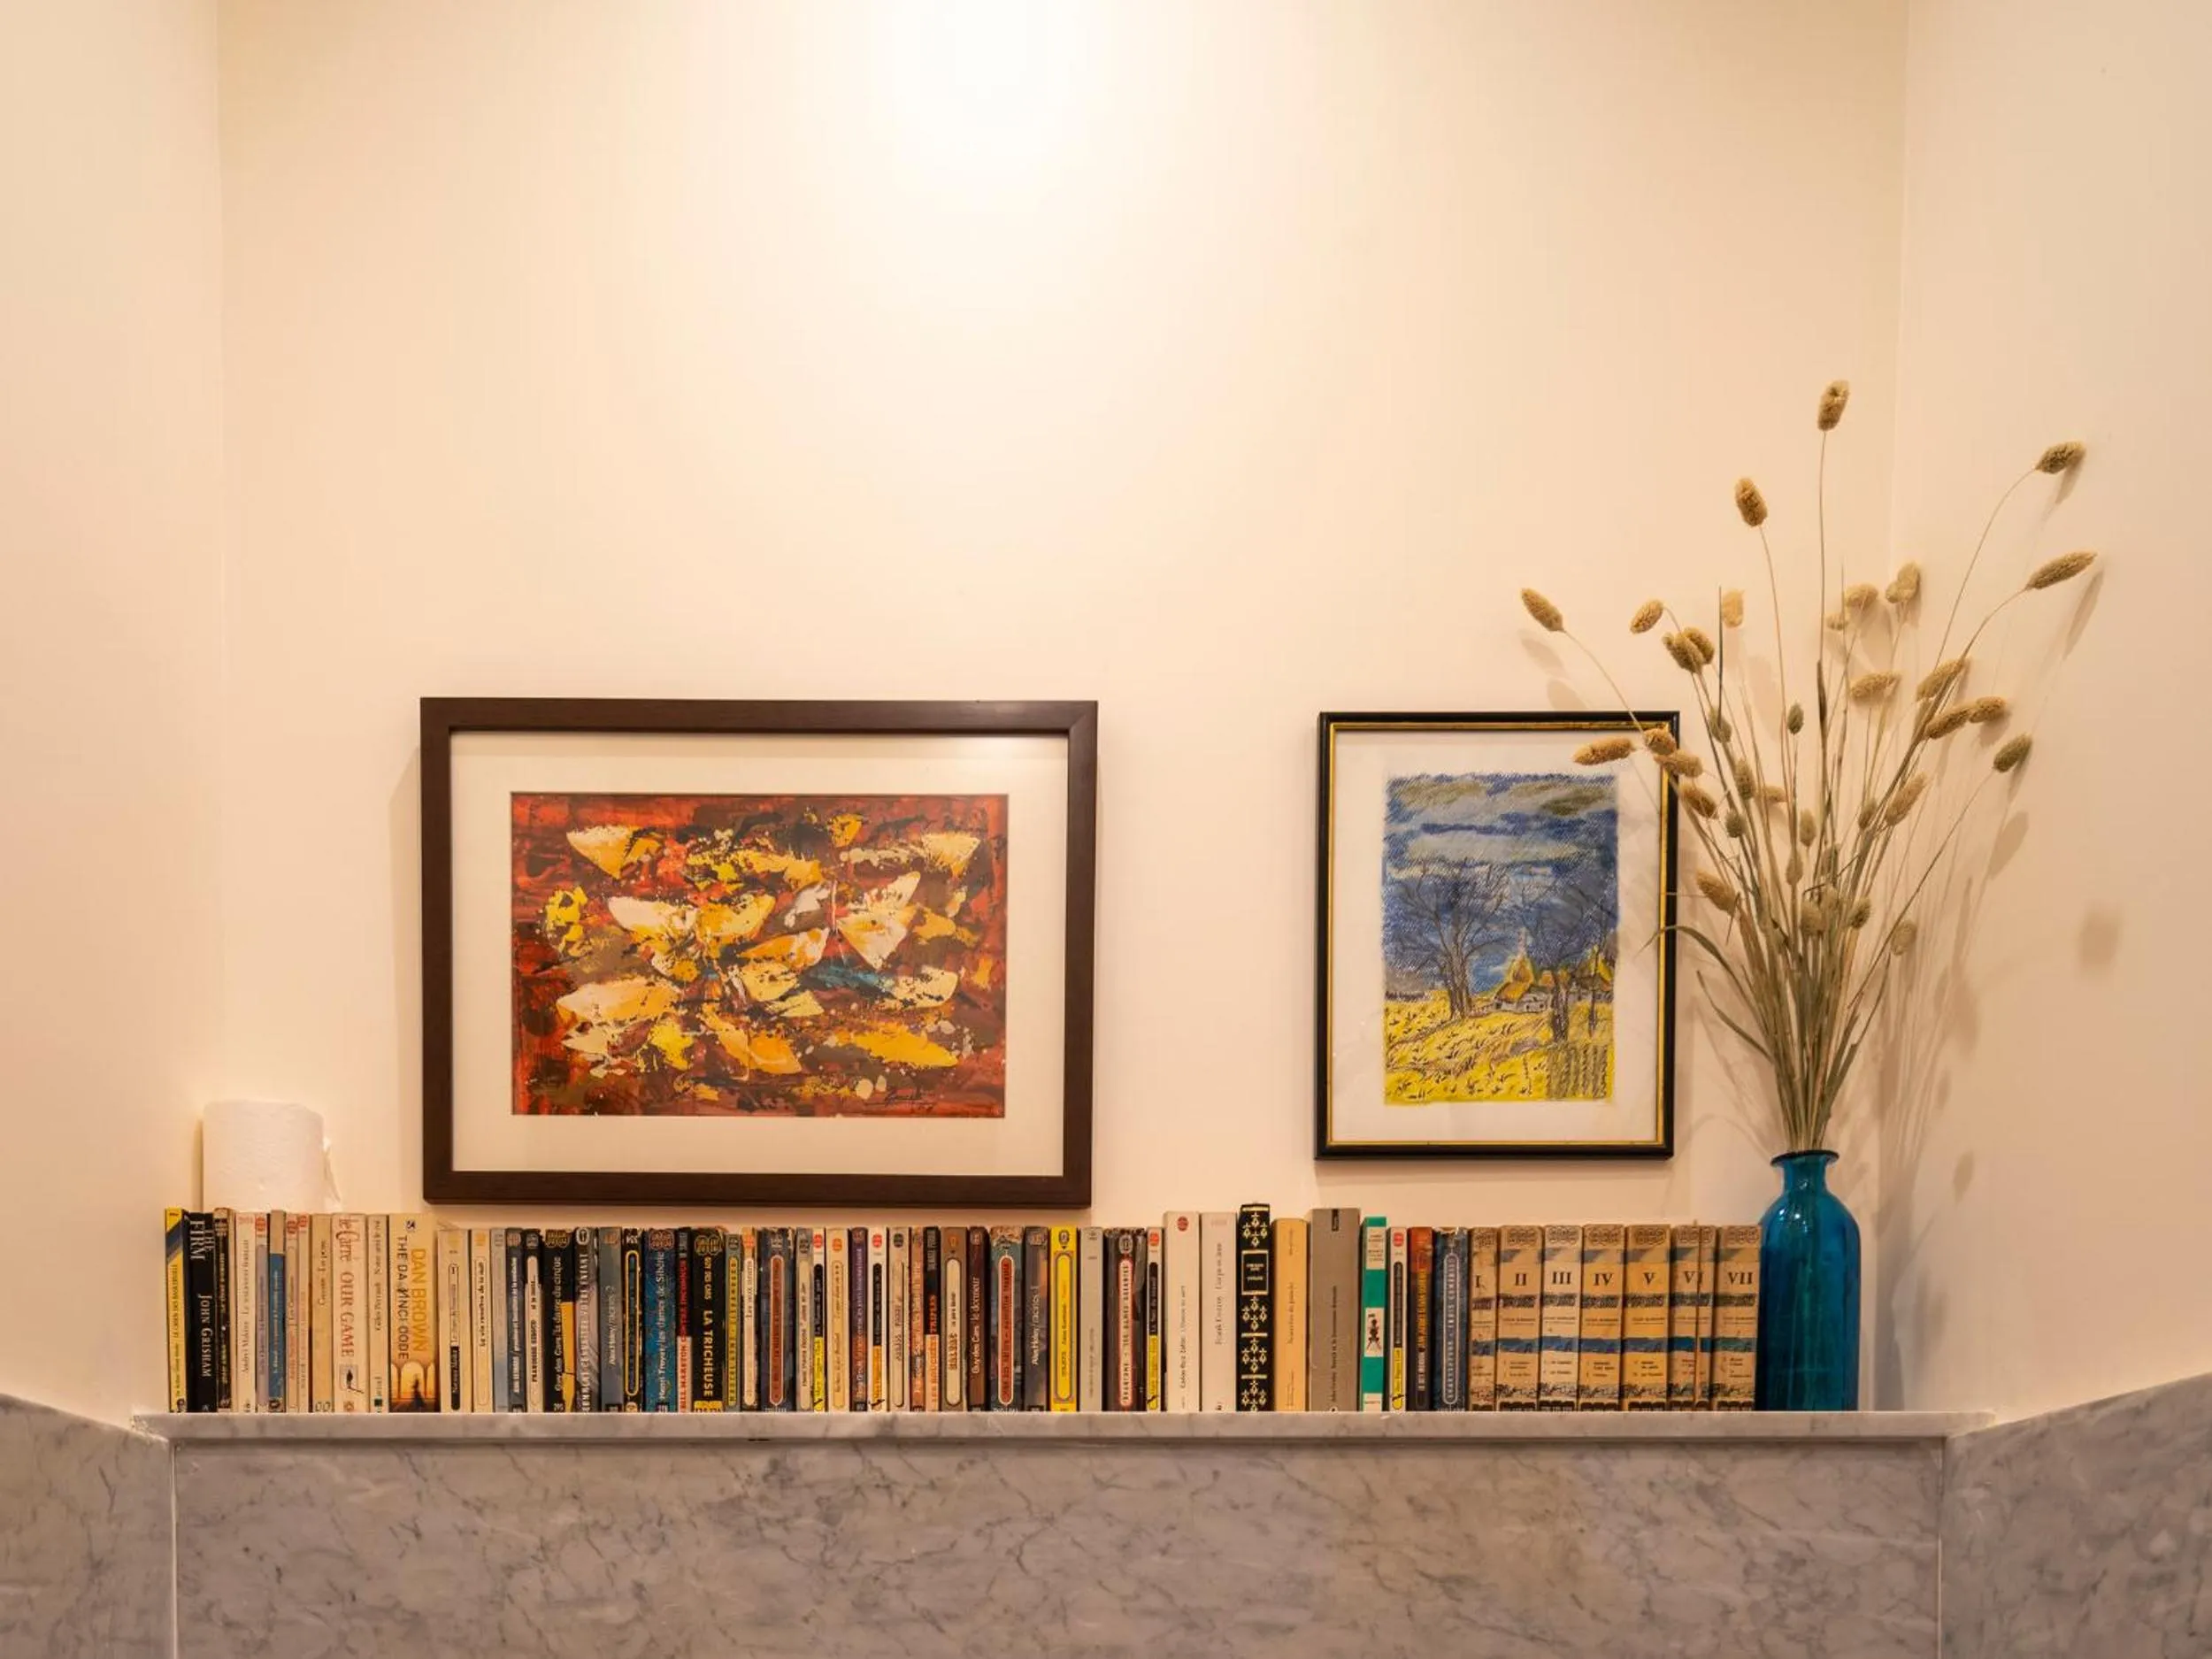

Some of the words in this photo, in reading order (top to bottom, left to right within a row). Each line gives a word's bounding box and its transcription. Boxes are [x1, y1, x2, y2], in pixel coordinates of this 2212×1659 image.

[189, 1219, 206, 1258] FIRM
[205, 1227, 214, 1249] THE
[397, 1235, 409, 1259] THE
[398, 1265, 409, 1281] DA
[411, 1248, 426, 1283] DAN
[340, 1271, 354, 1304] OUR
[1515, 1273, 1527, 1286] II
[1553, 1271, 1571, 1285] III
[1594, 1273, 1613, 1286] IV
[1644, 1272, 1656, 1285] V
[1685, 1271, 1704, 1285] VI
[1728, 1272, 1754, 1285] VII
[198, 1293, 212, 1322] JOHN
[411, 1288, 427, 1350] BROWN
[703, 1309, 713, 1324] LA
[340, 1311, 354, 1356] GAME
[398, 1324, 409, 1357] CODE
[200, 1326, 213, 1375] GRISHAM
[703, 1329, 713, 1394] TRICHEUSE
[972, 1359, 980, 1373] Guy
